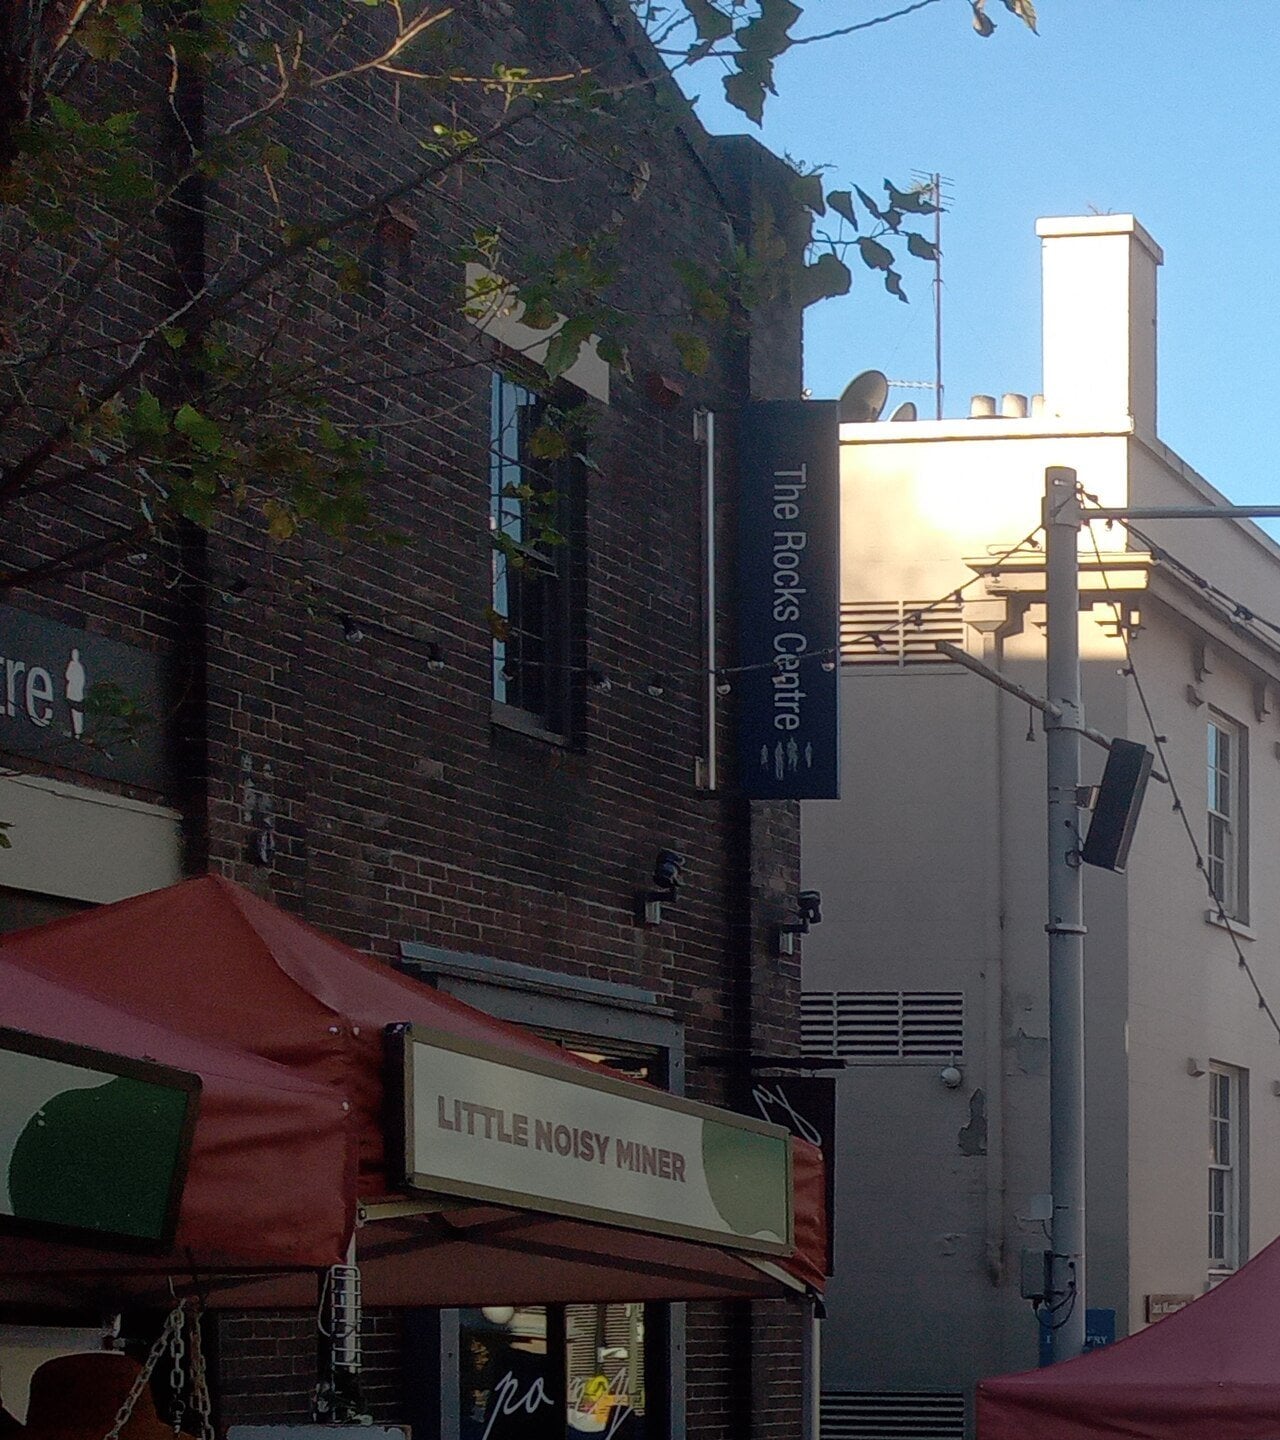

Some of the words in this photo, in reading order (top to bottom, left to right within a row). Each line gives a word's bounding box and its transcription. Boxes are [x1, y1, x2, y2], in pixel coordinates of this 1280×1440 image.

[773, 463, 807, 520] The
[773, 531, 807, 622] Rocks
[773, 632, 808, 731] Centre
[438, 1095, 529, 1147] LITTLE
[535, 1119, 611, 1165] NOISY
[615, 1138, 687, 1183] MINER
